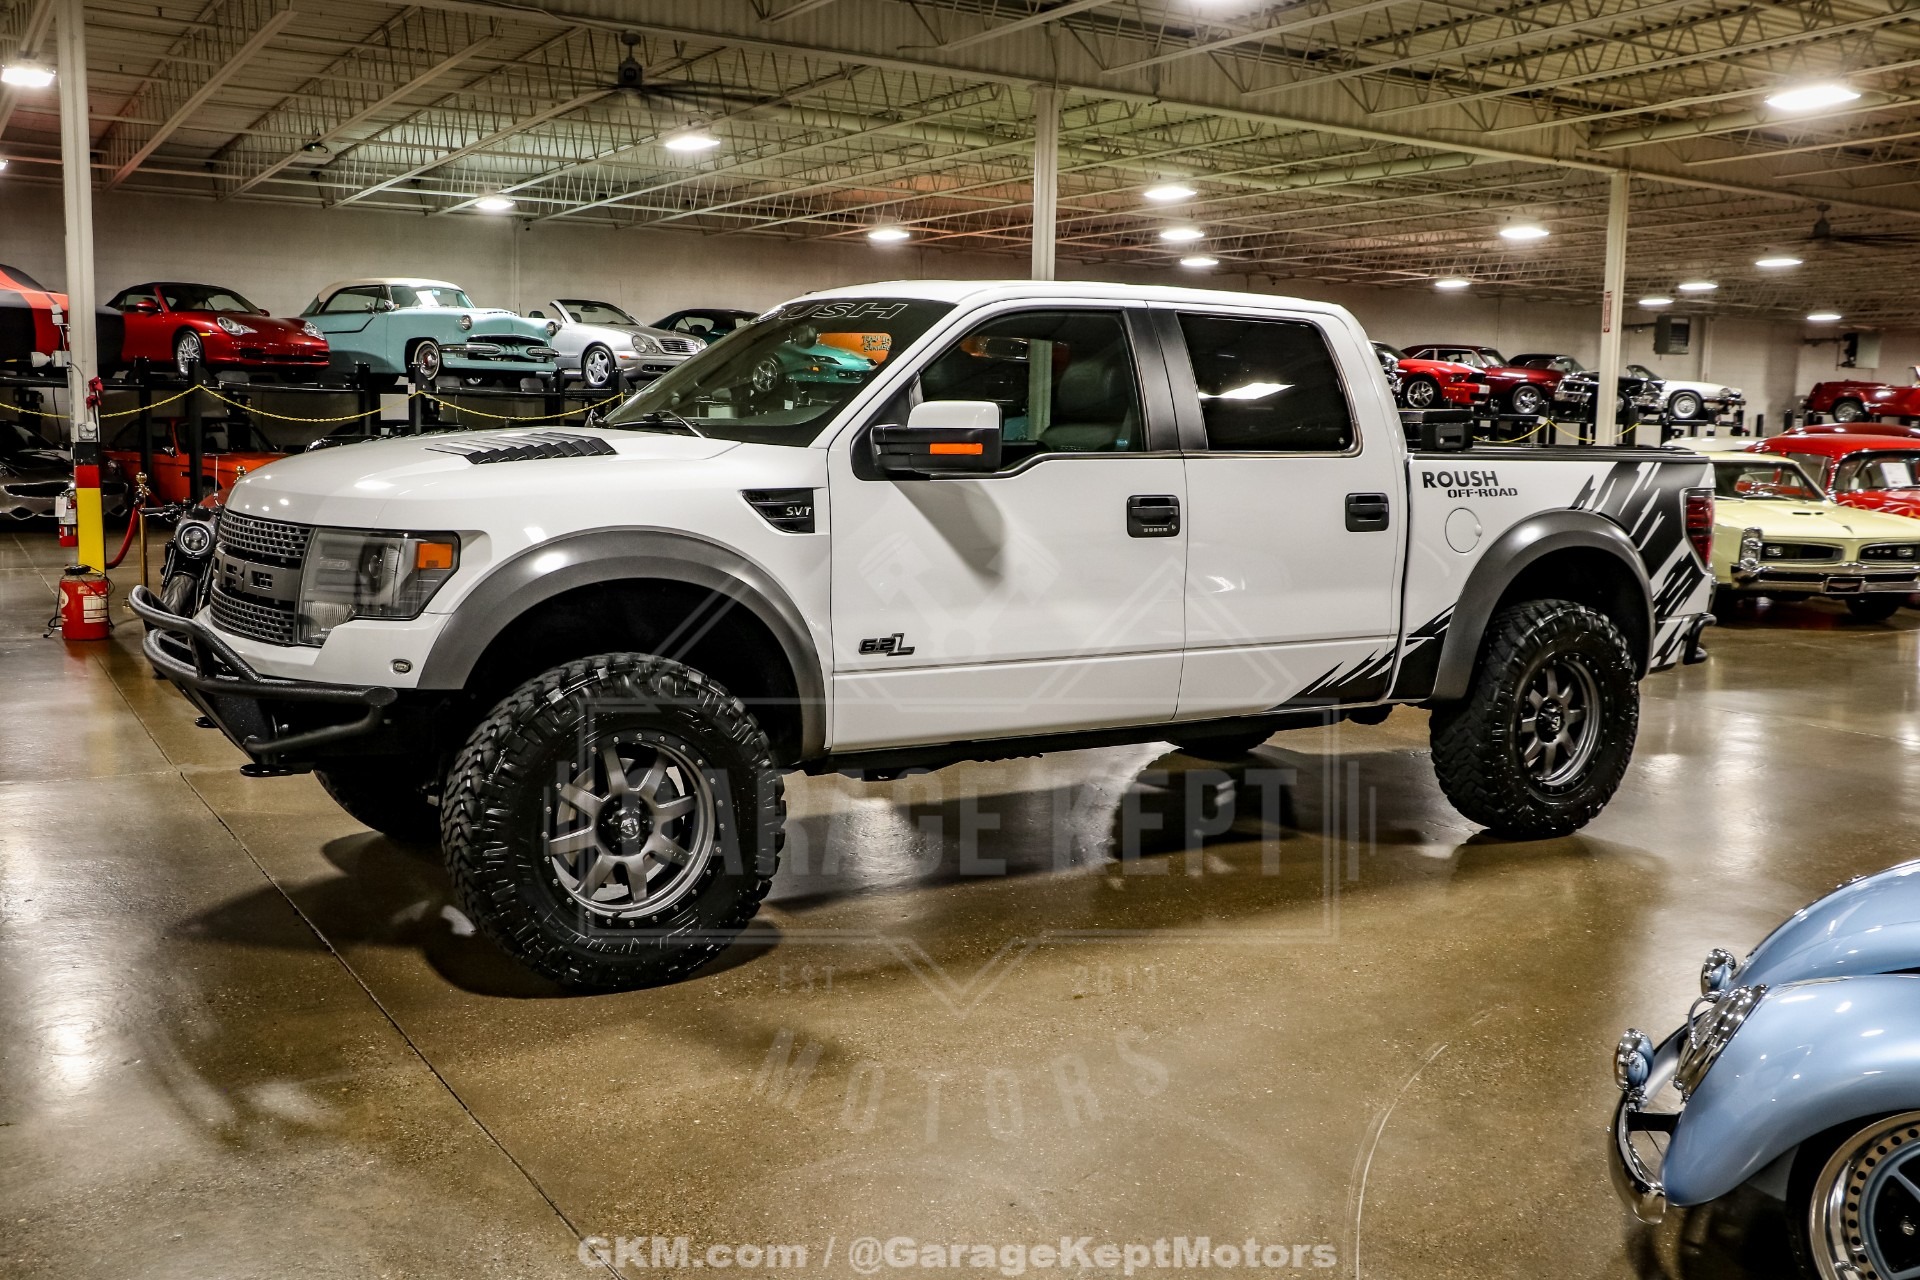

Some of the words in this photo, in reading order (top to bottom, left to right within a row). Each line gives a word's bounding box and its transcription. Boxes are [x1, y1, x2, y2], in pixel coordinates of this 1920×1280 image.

[1421, 470, 1499, 489] ROUSH
[1447, 487, 1518, 498] OFF-ROAD
[785, 506, 812, 516] SVT
